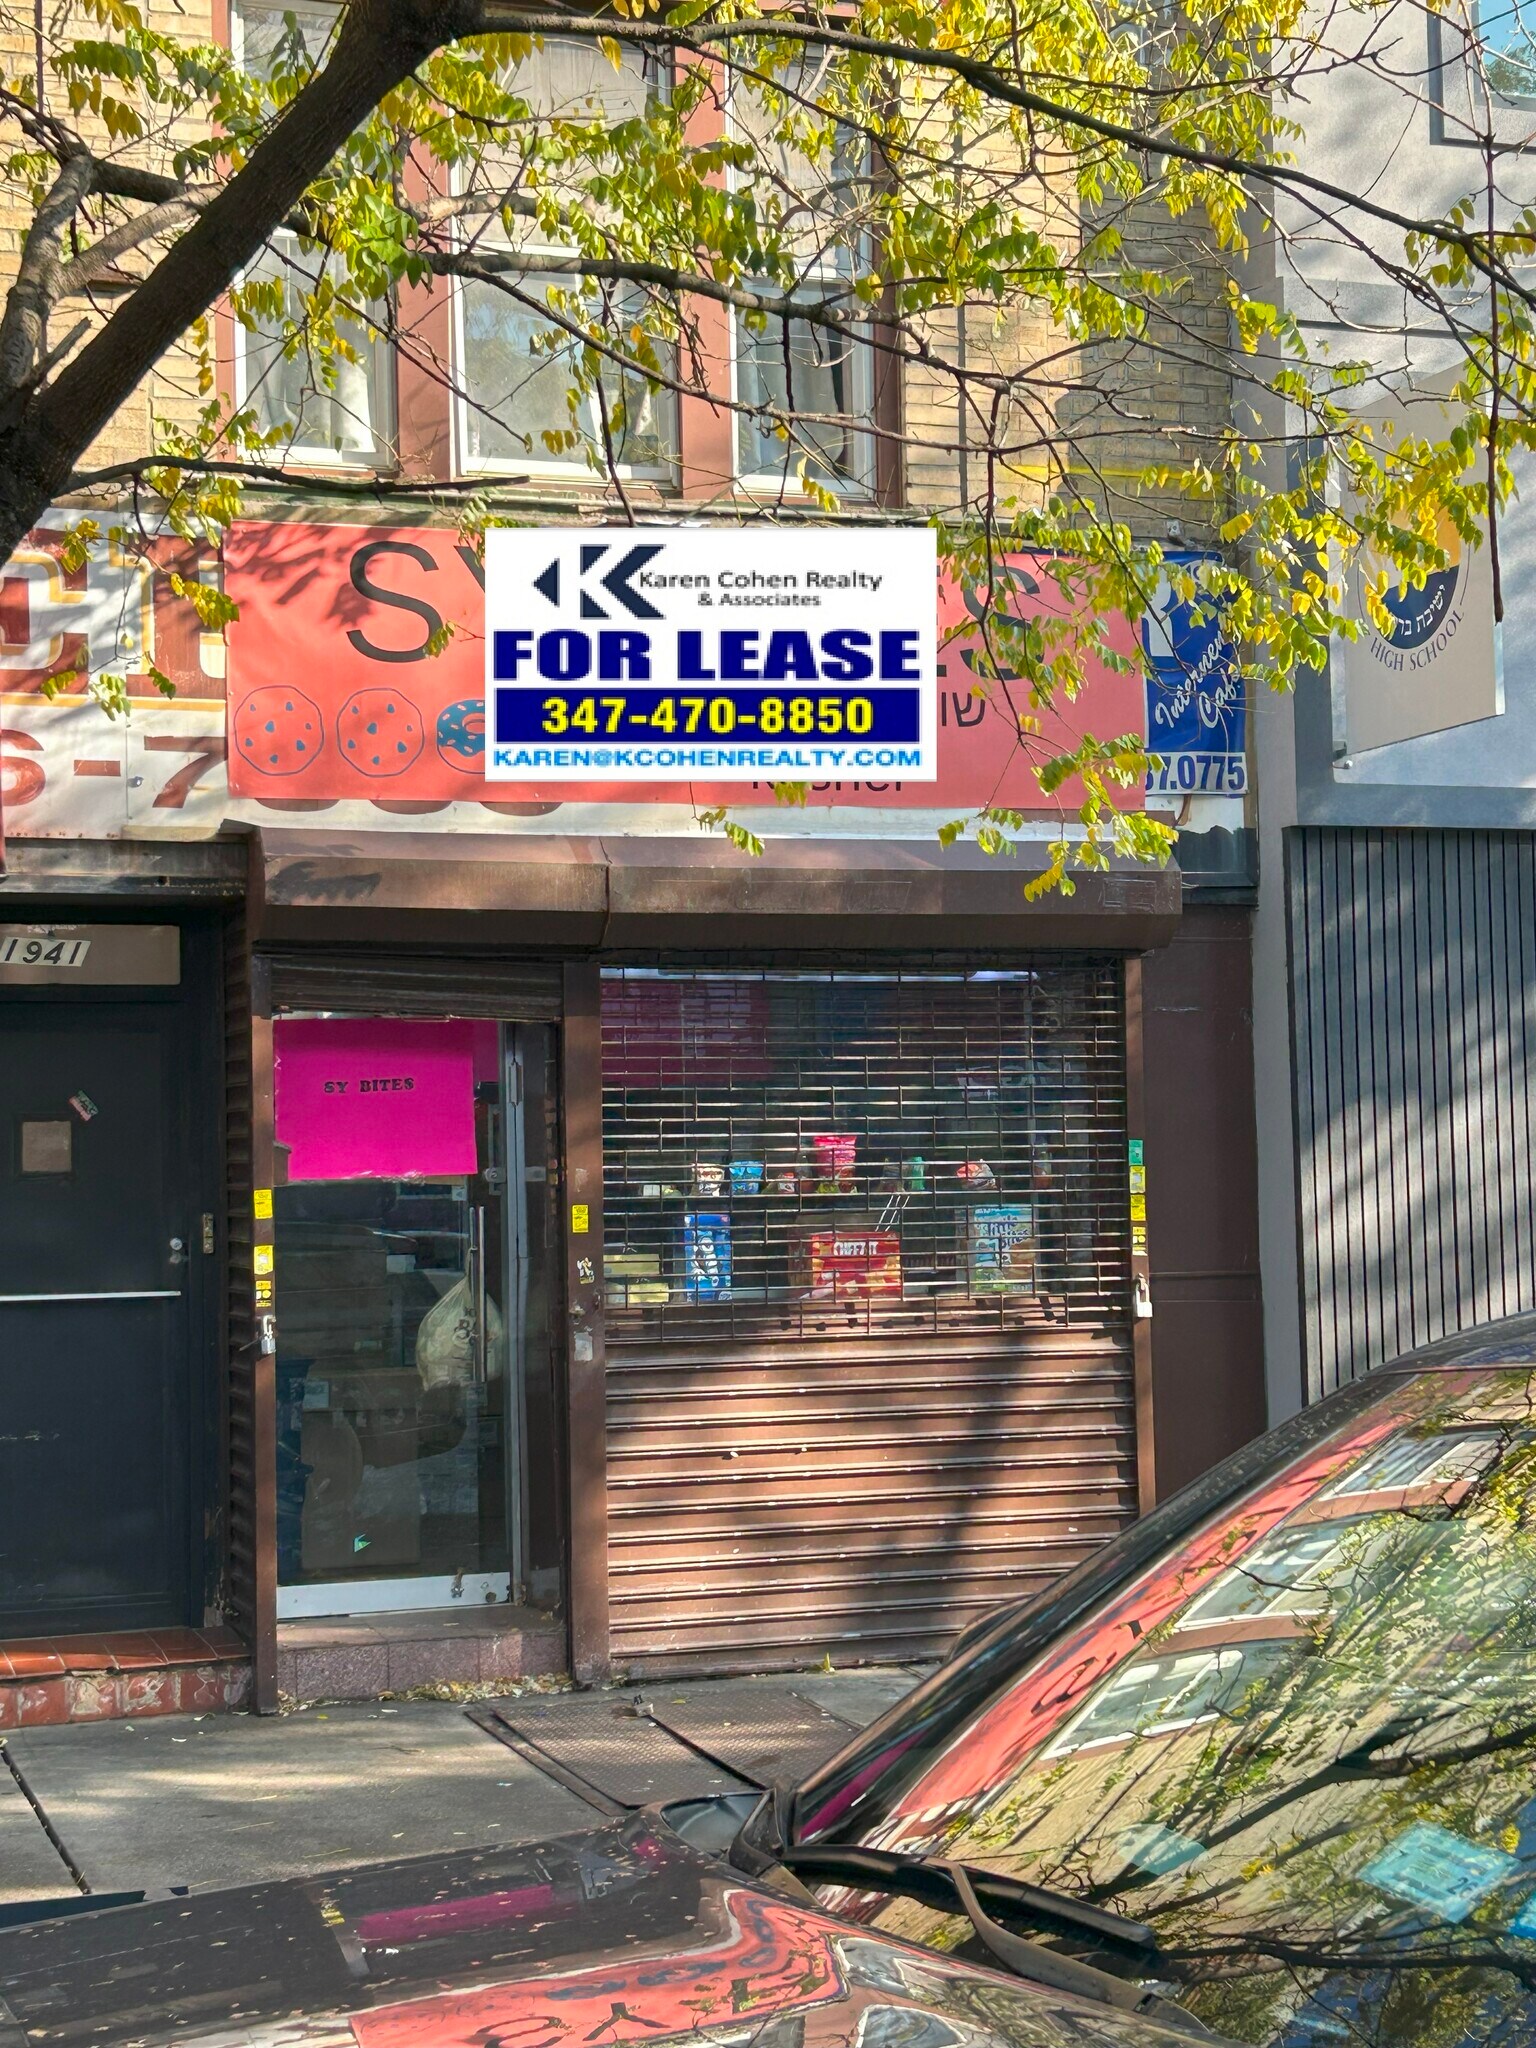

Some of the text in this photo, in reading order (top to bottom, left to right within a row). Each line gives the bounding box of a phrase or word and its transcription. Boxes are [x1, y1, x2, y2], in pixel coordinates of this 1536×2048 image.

[1370, 610, 1465, 672] HIGH SCHOOL
[5, 939, 82, 965] 1941
[324, 1078, 414, 1093] SY BITES
